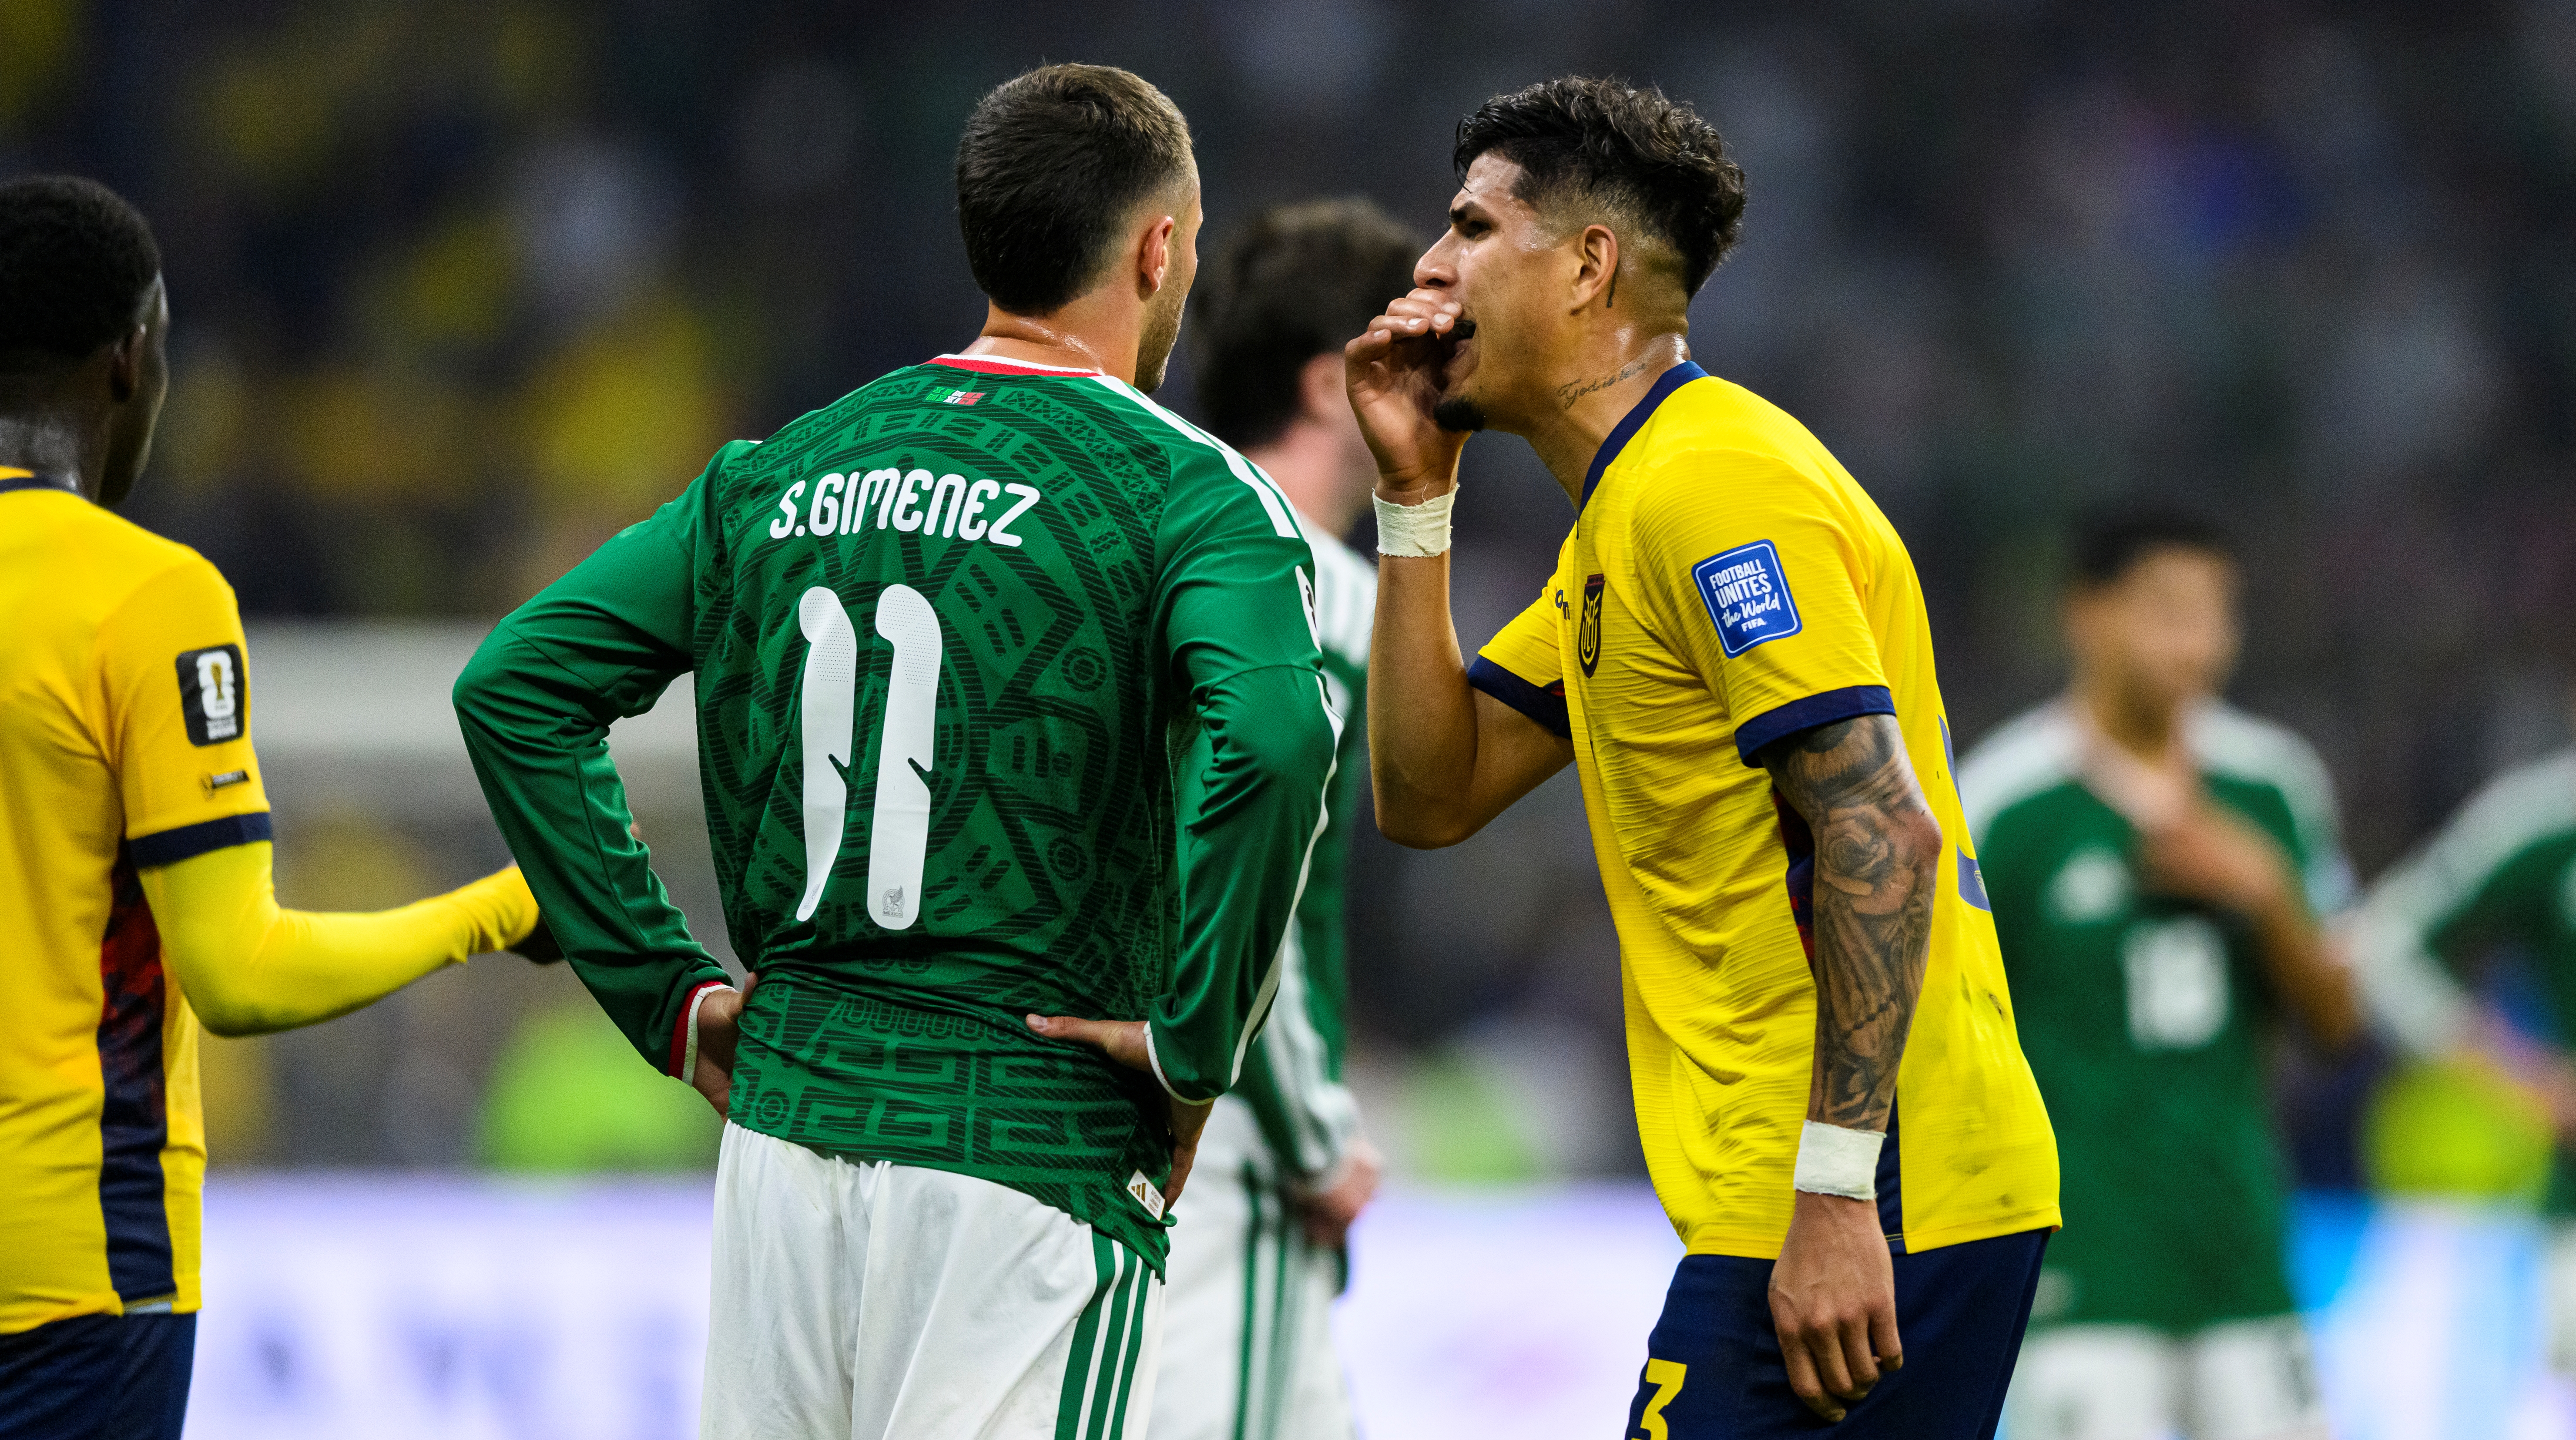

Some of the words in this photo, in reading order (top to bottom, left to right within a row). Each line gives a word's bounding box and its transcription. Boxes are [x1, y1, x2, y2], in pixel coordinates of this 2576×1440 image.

[769, 468, 1040, 547] S.GIMENEZ
[1709, 559, 1766, 589] FOOTBALL
[1714, 573, 1772, 608] UNITES
[1721, 609, 1741, 628] the
[1739, 592, 1781, 618] World
[1741, 618, 1766, 632] FIFA
[796, 584, 943, 930] 11
[1631, 1358, 1687, 1440] 3
